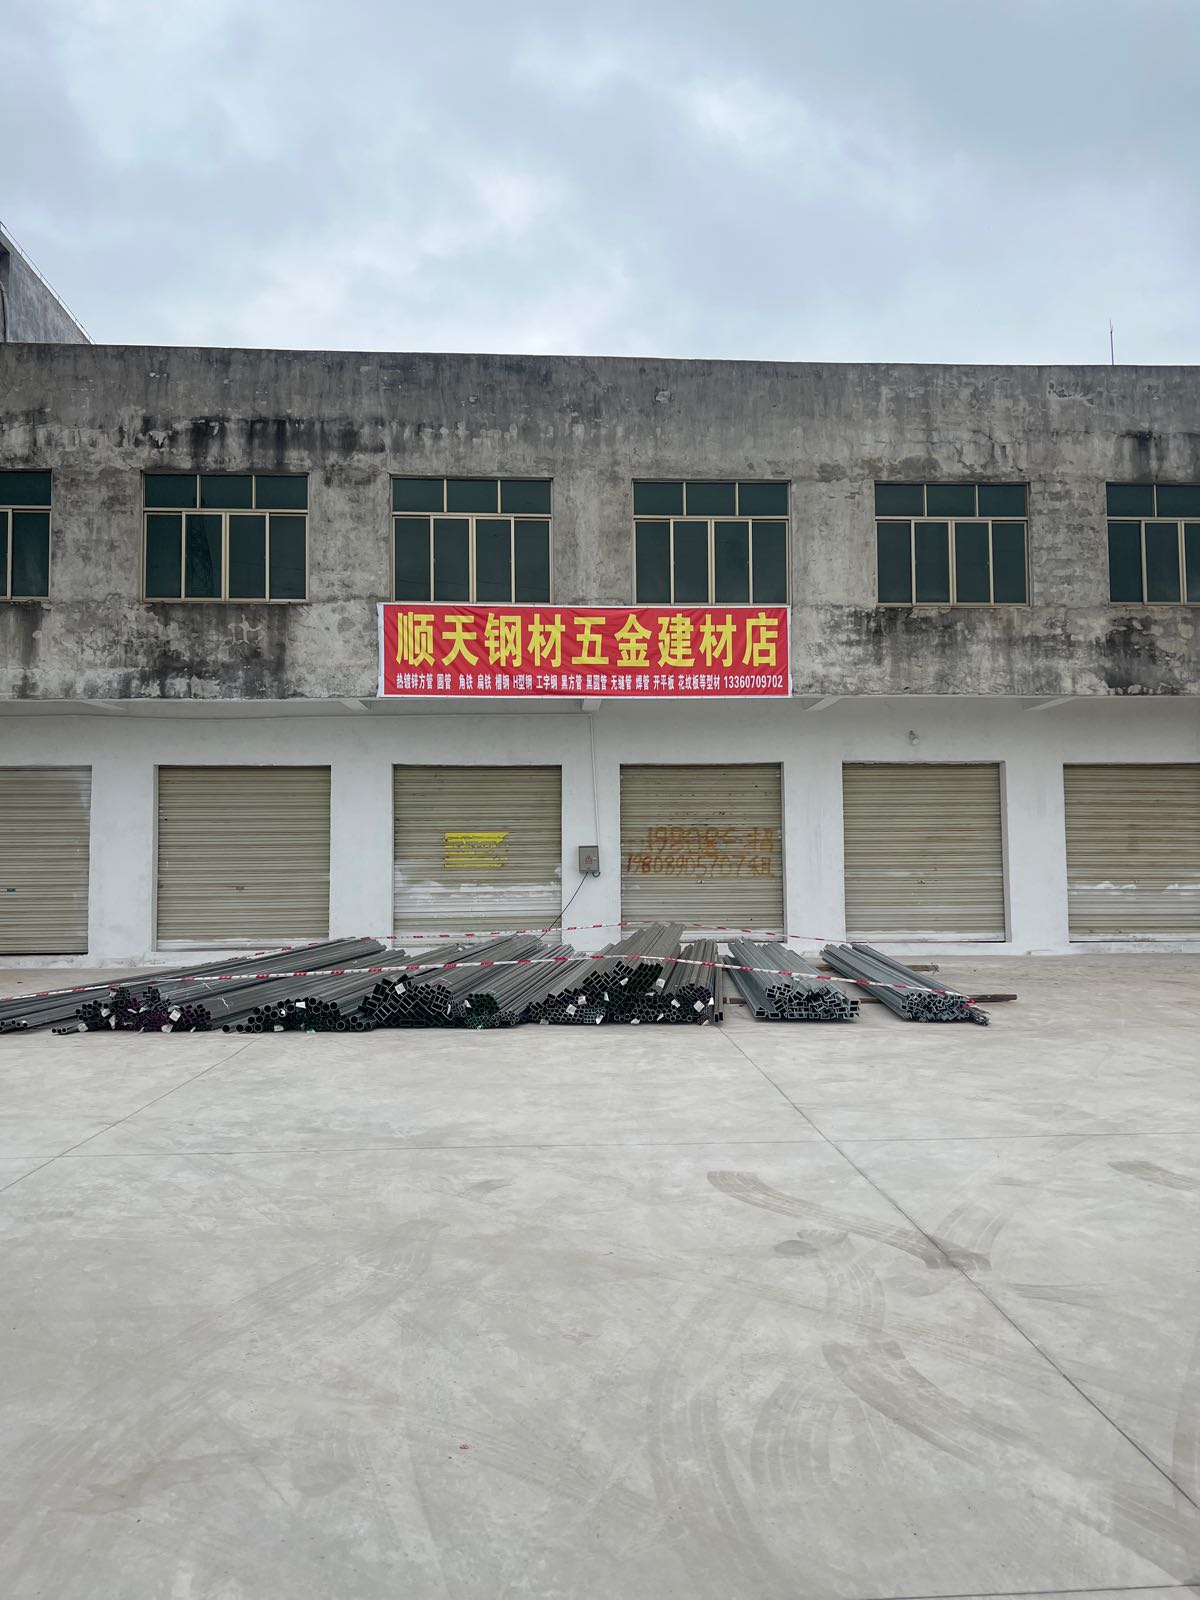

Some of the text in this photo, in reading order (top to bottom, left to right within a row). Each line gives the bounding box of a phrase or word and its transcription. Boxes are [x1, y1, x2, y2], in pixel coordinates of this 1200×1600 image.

[396, 612, 779, 668] 顺天钢材五金建材店
[458, 674, 473, 690] 角铁
[477, 674, 492, 690] 扁铁
[495, 674, 510, 690] 槽钢
[512, 674, 533, 690] H型钢
[536, 674, 558, 690] 工字钢
[560, 674, 583, 690] 黑方管
[585, 674, 608, 691] 黑圆管
[610, 674, 632, 691] 无缝管
[635, 674, 650, 691] 焊管
[653, 674, 675, 691] 开平板
[677, 674, 721, 691] 花纹板等型材
[723, 674, 783, 689] 13360709702
